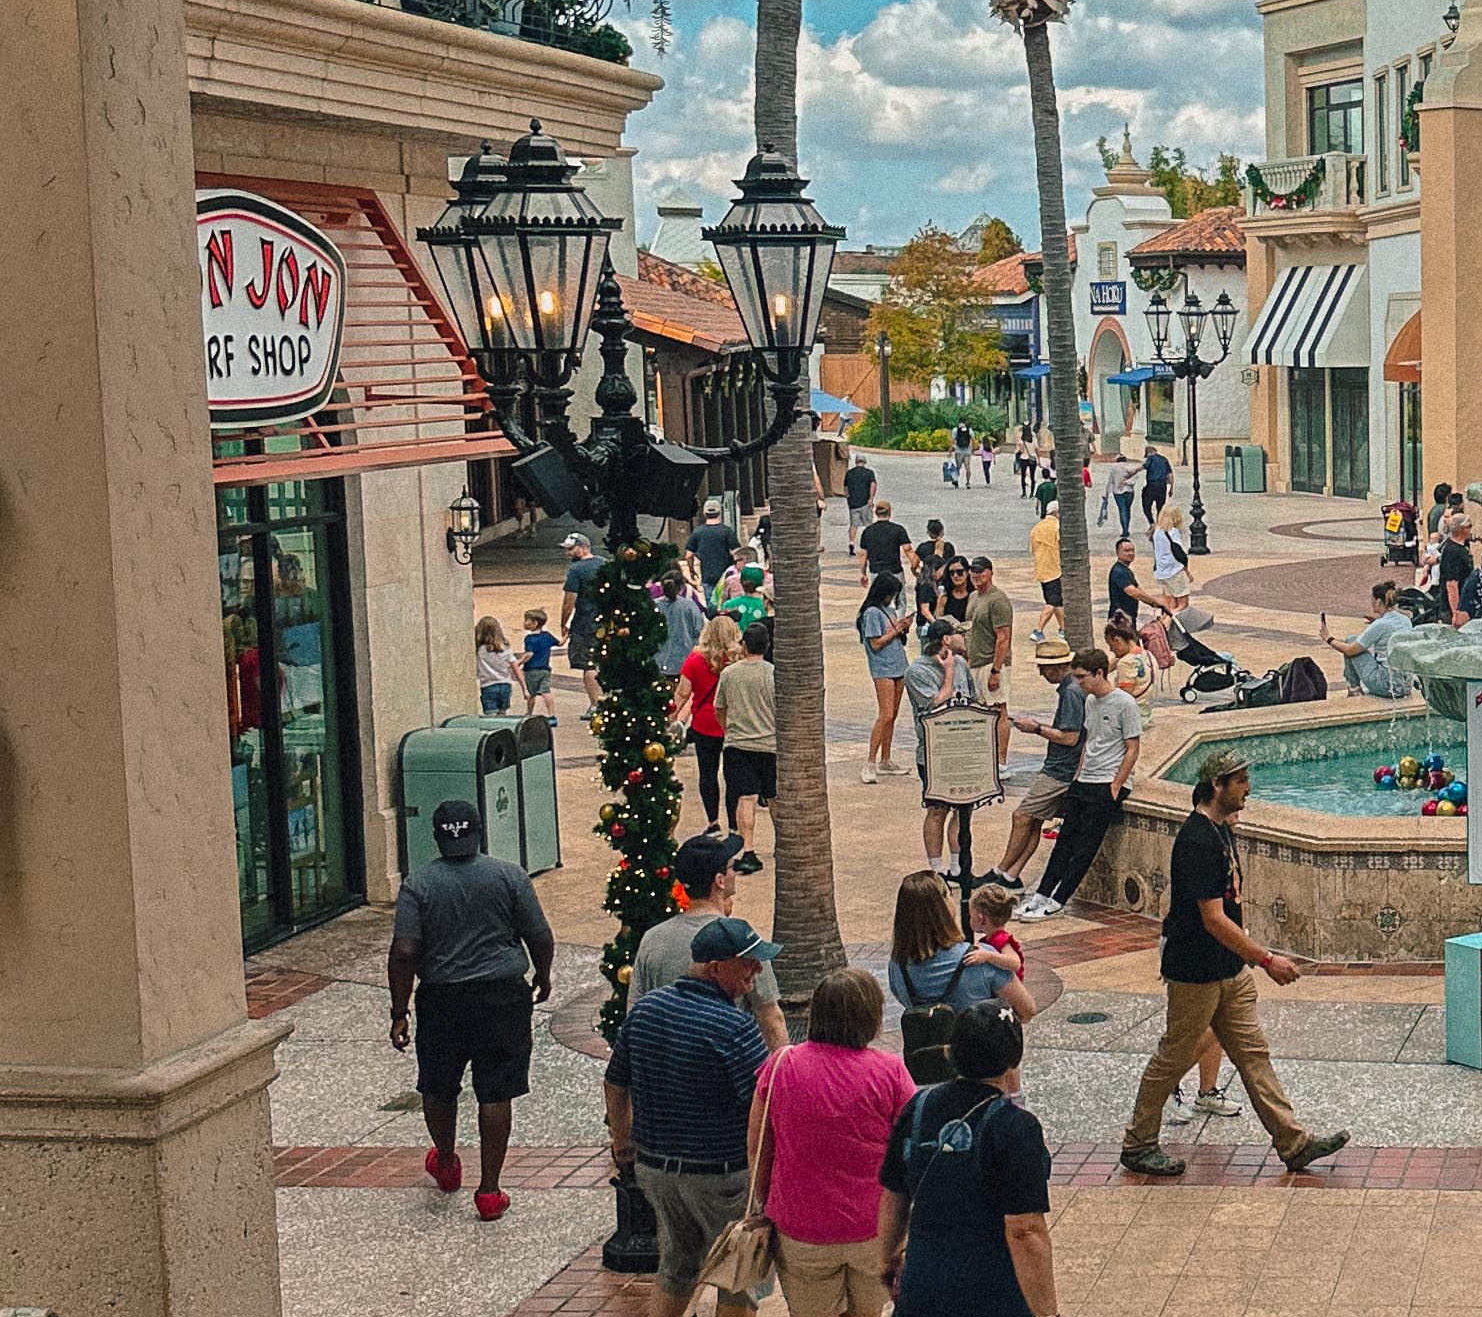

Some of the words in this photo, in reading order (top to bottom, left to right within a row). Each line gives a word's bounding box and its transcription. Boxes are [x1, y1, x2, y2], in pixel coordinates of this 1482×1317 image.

[245, 236, 332, 331] JON
[207, 334, 235, 380] RF
[249, 334, 312, 377] SHOP
